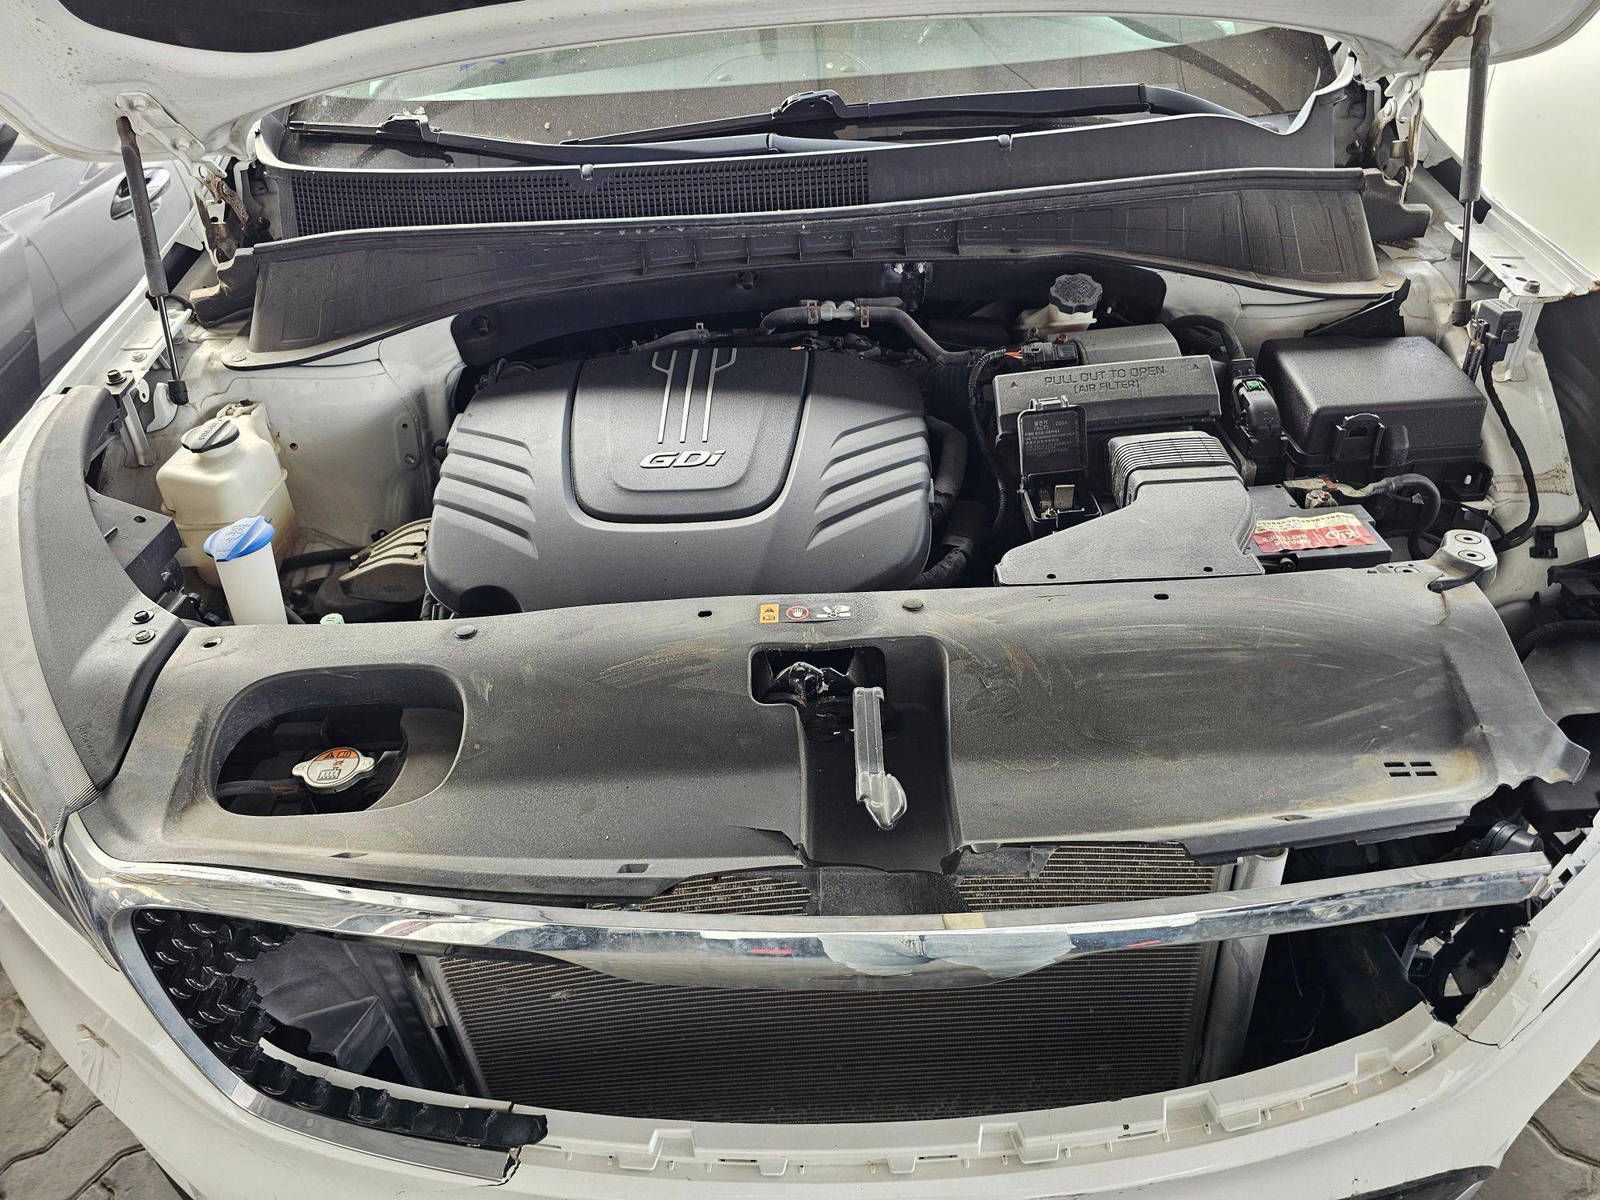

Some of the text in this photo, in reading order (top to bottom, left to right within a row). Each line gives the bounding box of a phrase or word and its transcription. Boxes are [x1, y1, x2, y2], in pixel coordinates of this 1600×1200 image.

[1044, 366, 1165, 386] PULL OUT TO OPEN
[1074, 379, 1140, 394] (AIR FILTER)
[639, 449, 727, 469] GDi
